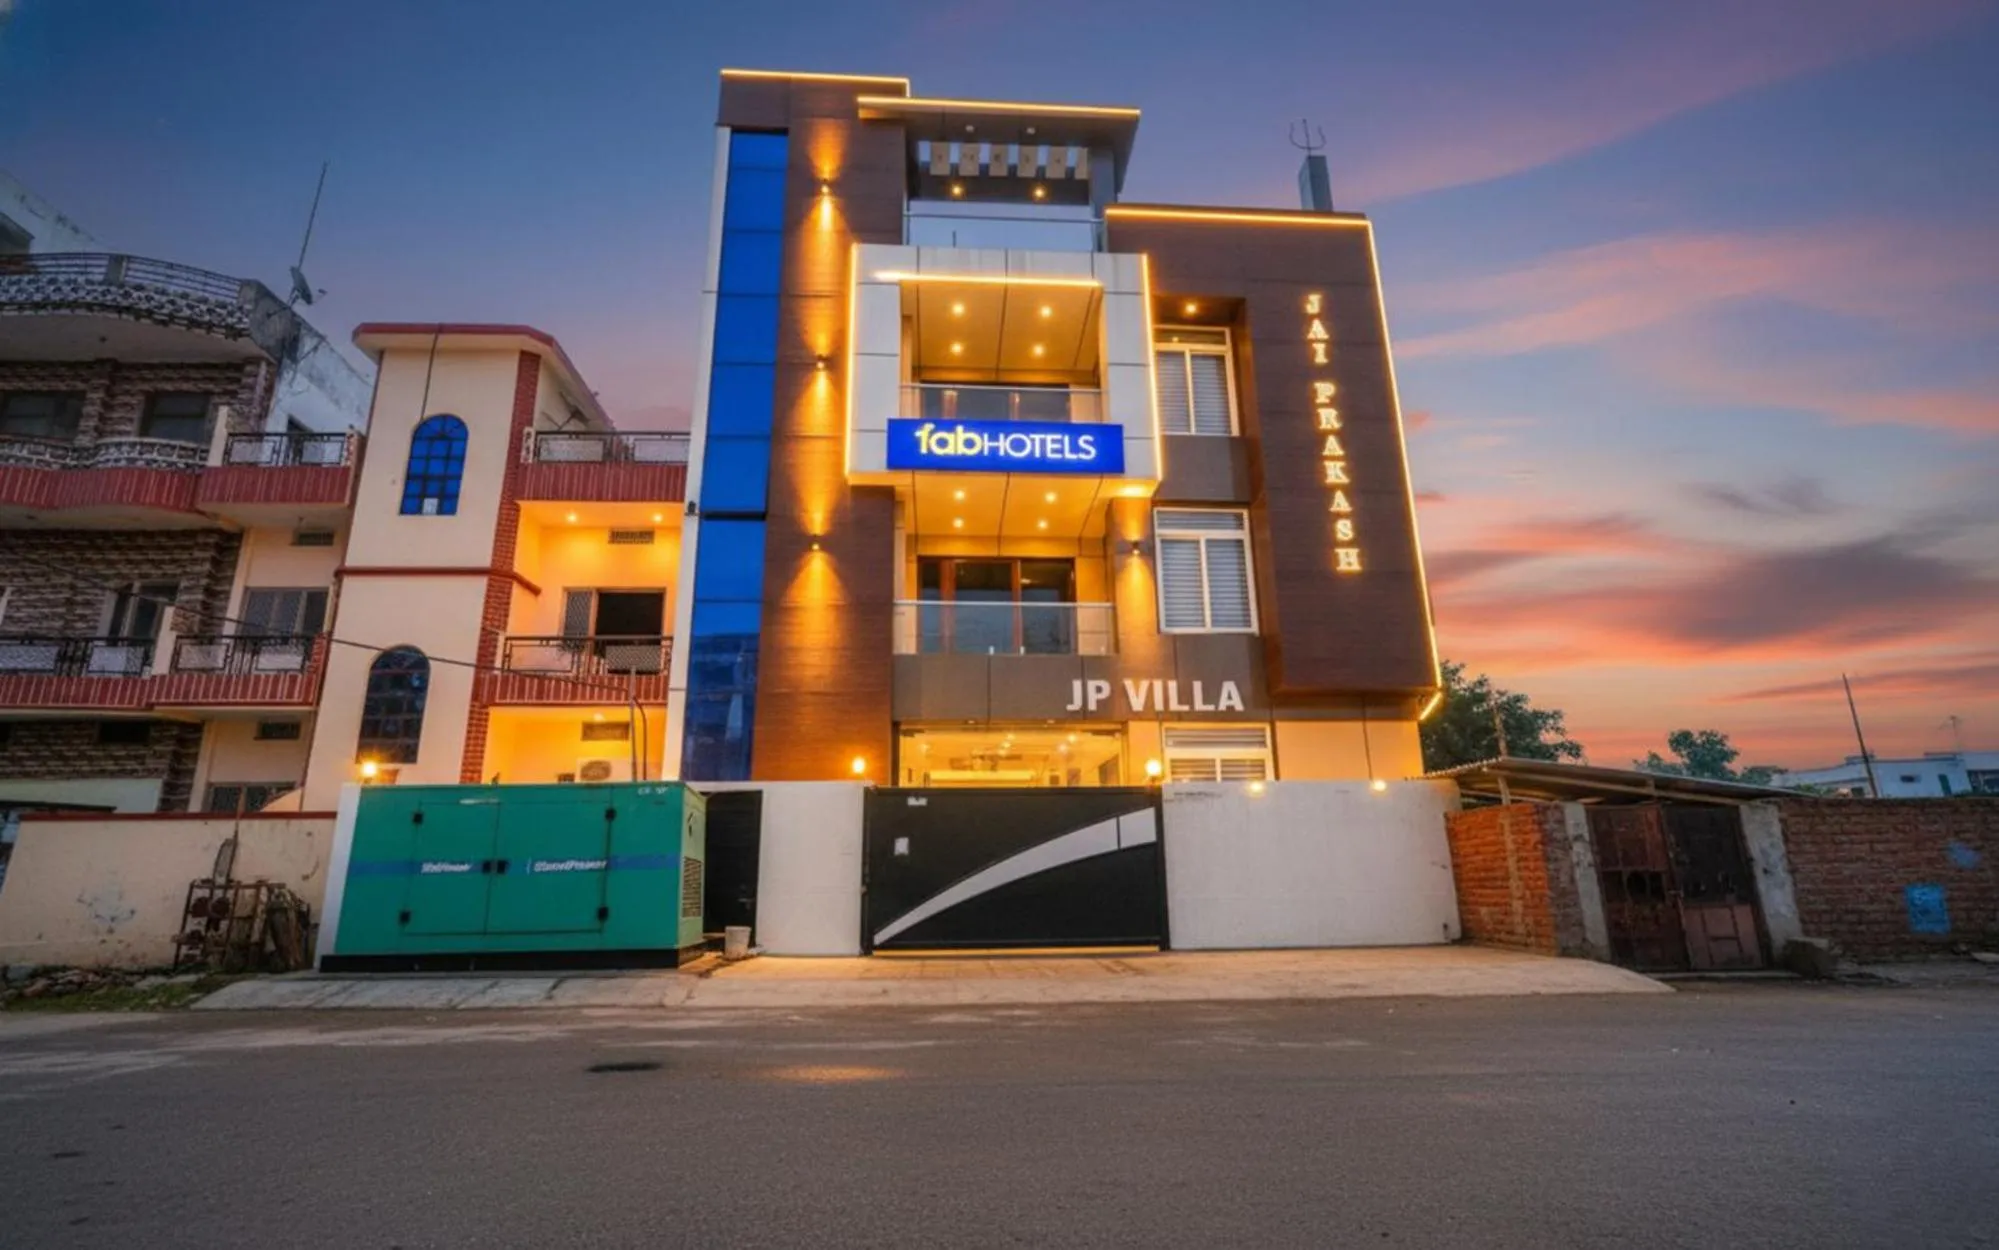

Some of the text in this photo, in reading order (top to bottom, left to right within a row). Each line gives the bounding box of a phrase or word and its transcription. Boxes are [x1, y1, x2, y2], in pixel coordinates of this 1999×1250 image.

[1305, 293, 1362, 571] JAI PRAKASH
[1066, 679, 1245, 712] JP VILLA
